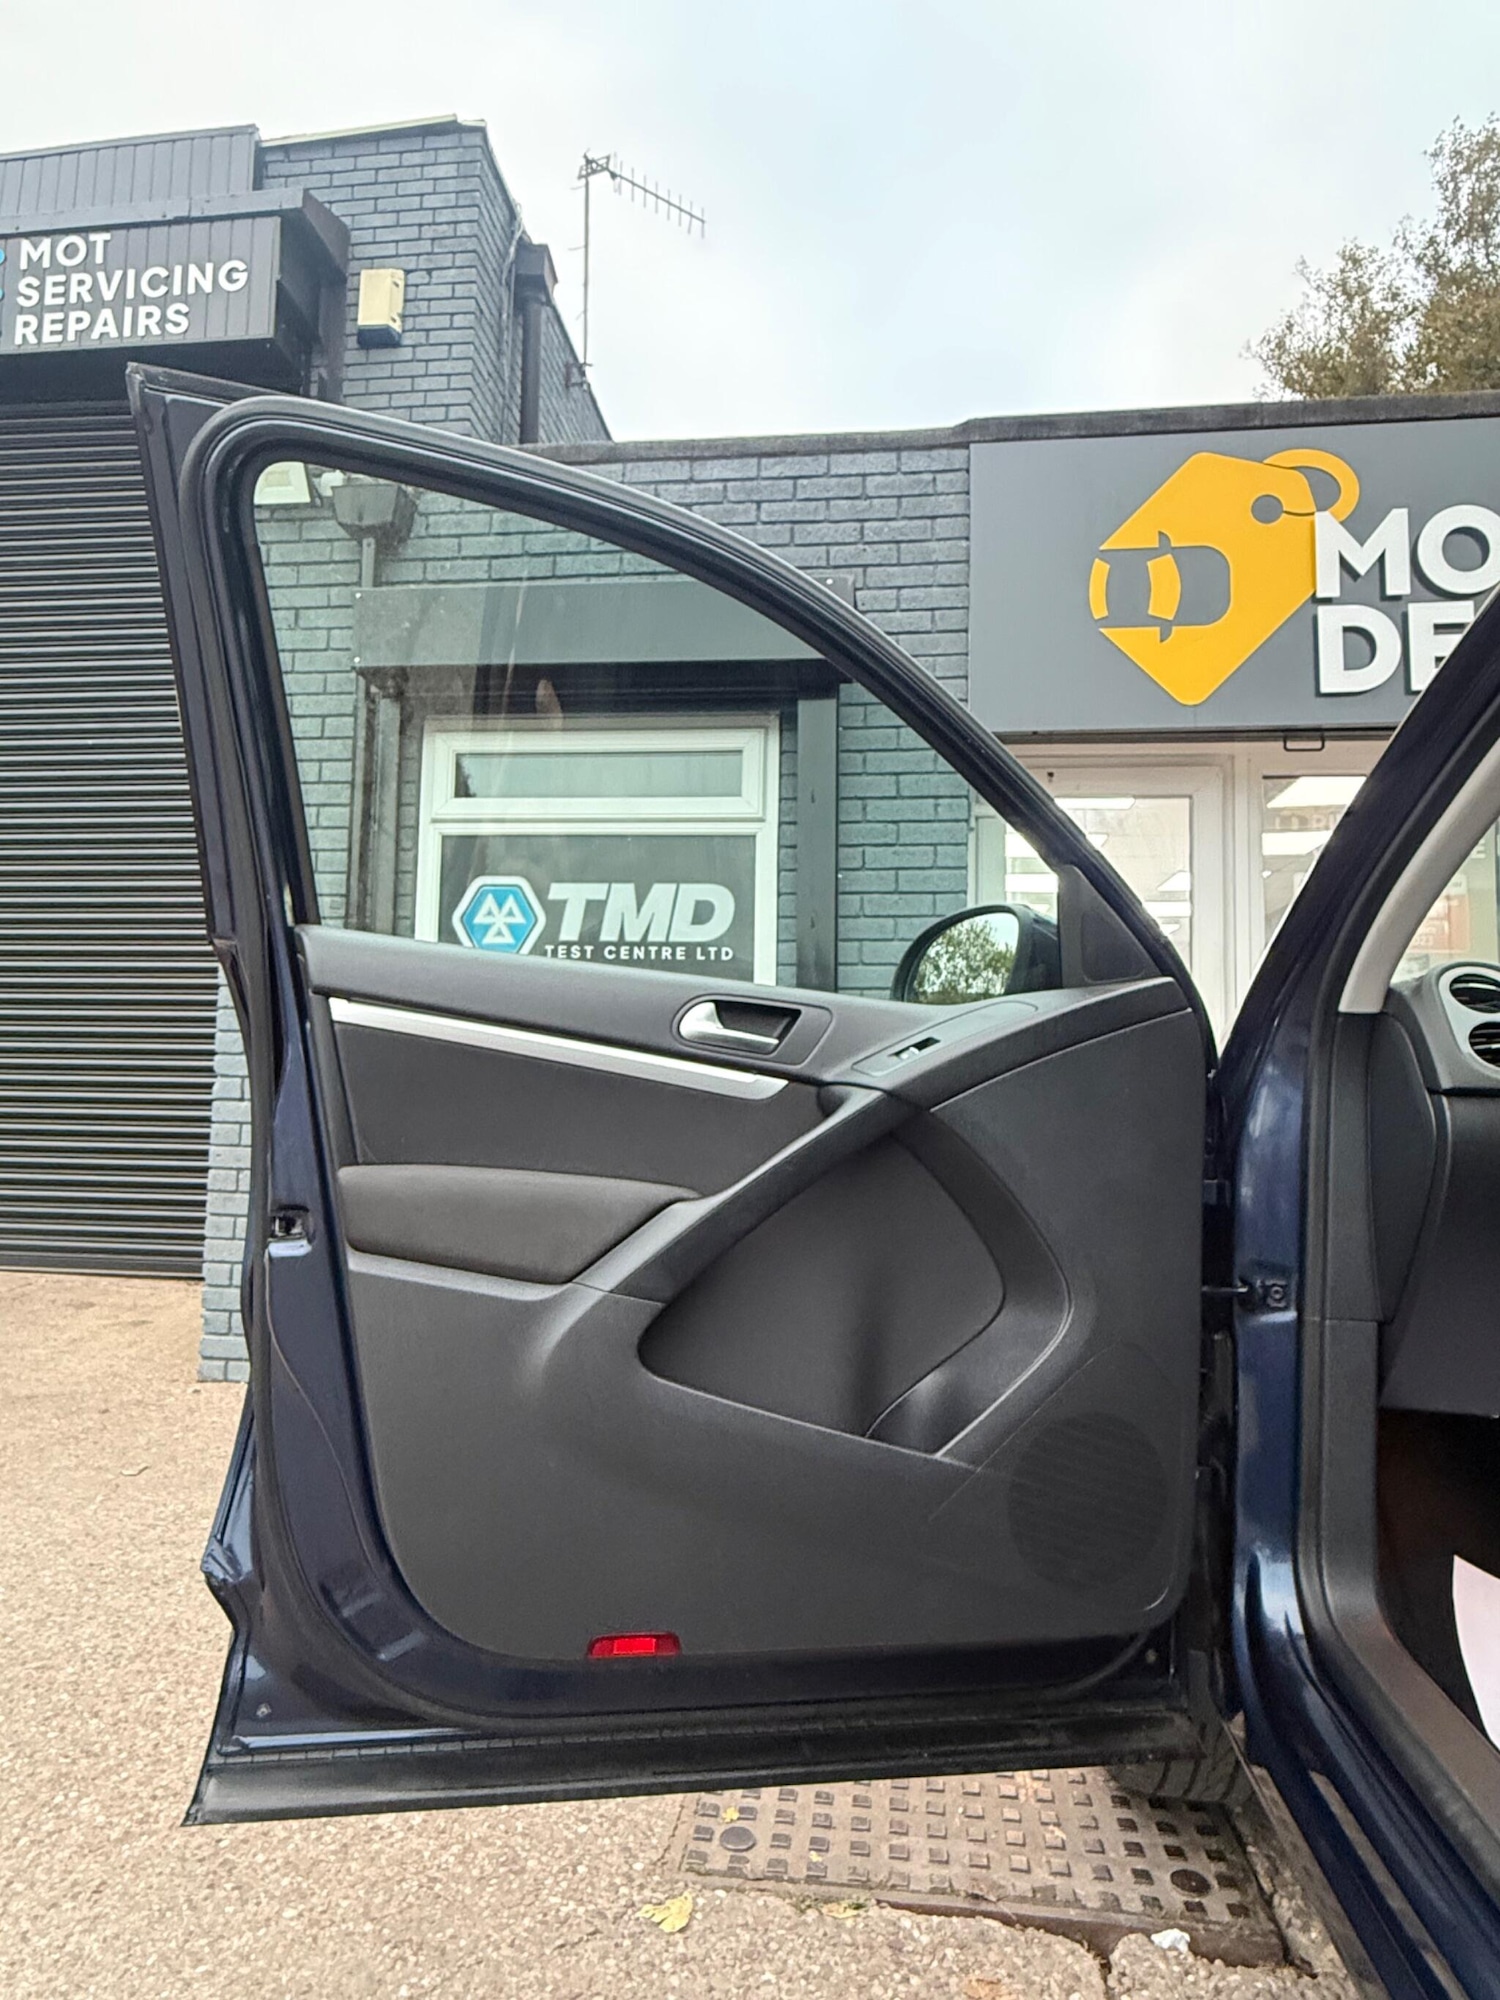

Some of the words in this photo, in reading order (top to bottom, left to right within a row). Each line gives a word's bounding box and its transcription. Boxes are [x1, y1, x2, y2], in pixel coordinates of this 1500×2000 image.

[20, 233, 111, 270] MOT
[16, 259, 248, 307] SERVICING
[14, 303, 190, 344] REPAIRS
[1314, 504, 1500, 598] MO
[547, 882, 735, 942] TMD
[544, 944, 595, 960] TEST
[603, 945, 687, 961] CENTRE
[697, 946, 734, 961] LTD
